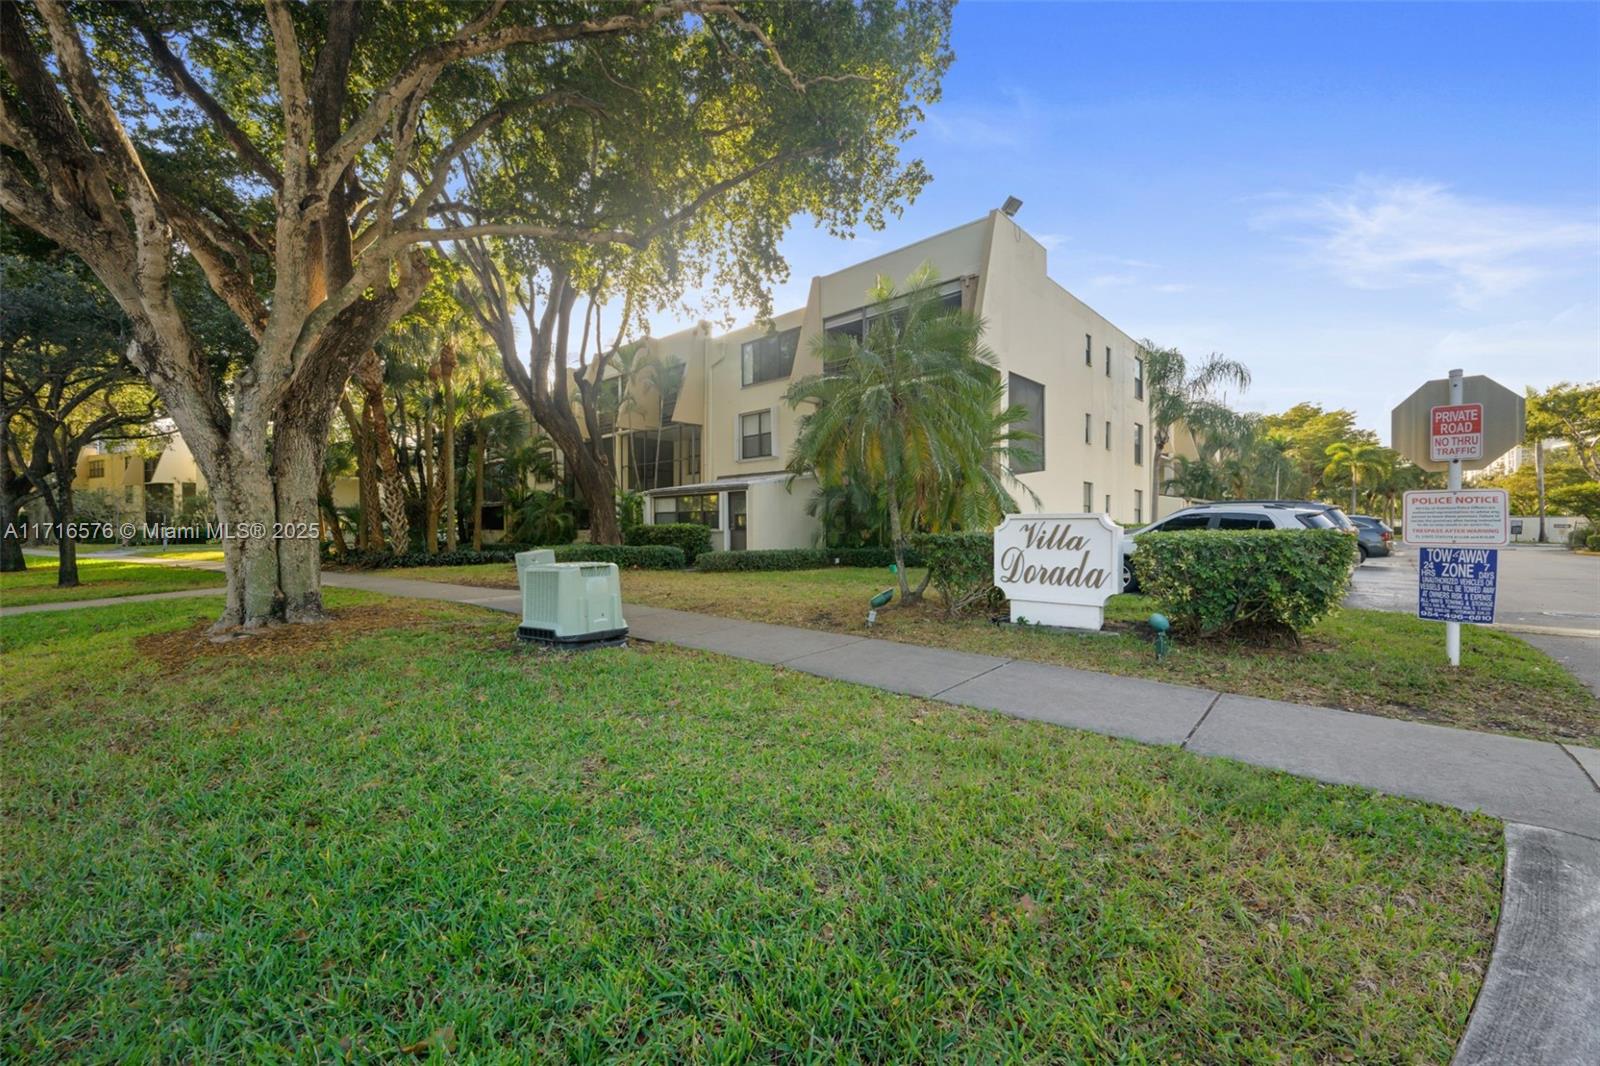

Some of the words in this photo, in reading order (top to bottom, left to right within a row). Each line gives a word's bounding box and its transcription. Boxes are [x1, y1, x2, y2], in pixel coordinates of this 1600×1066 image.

[1435, 409, 1478, 423] PRIVATE
[1440, 421, 1473, 434] ROAD
[1434, 437, 1449, 447] NO
[1451, 435, 1478, 446] THRU
[1437, 446, 1476, 456] TRAFFIC
[1412, 496, 1452, 505] POLICE
[1455, 495, 1499, 504] NOTICE
[1019, 521, 1091, 551] Villa
[1458, 549, 1489, 564] AWAY
[1000, 546, 1112, 589] Dorada
[1423, 561, 1434, 569] 24
[1441, 563, 1475, 578] ZONE
[1420, 569, 1436, 577] HRS
[1478, 571, 1495, 579] DAYS
[1460, 578, 1484, 586] VEHICLES
[1442, 584, 1453, 592] WILL
